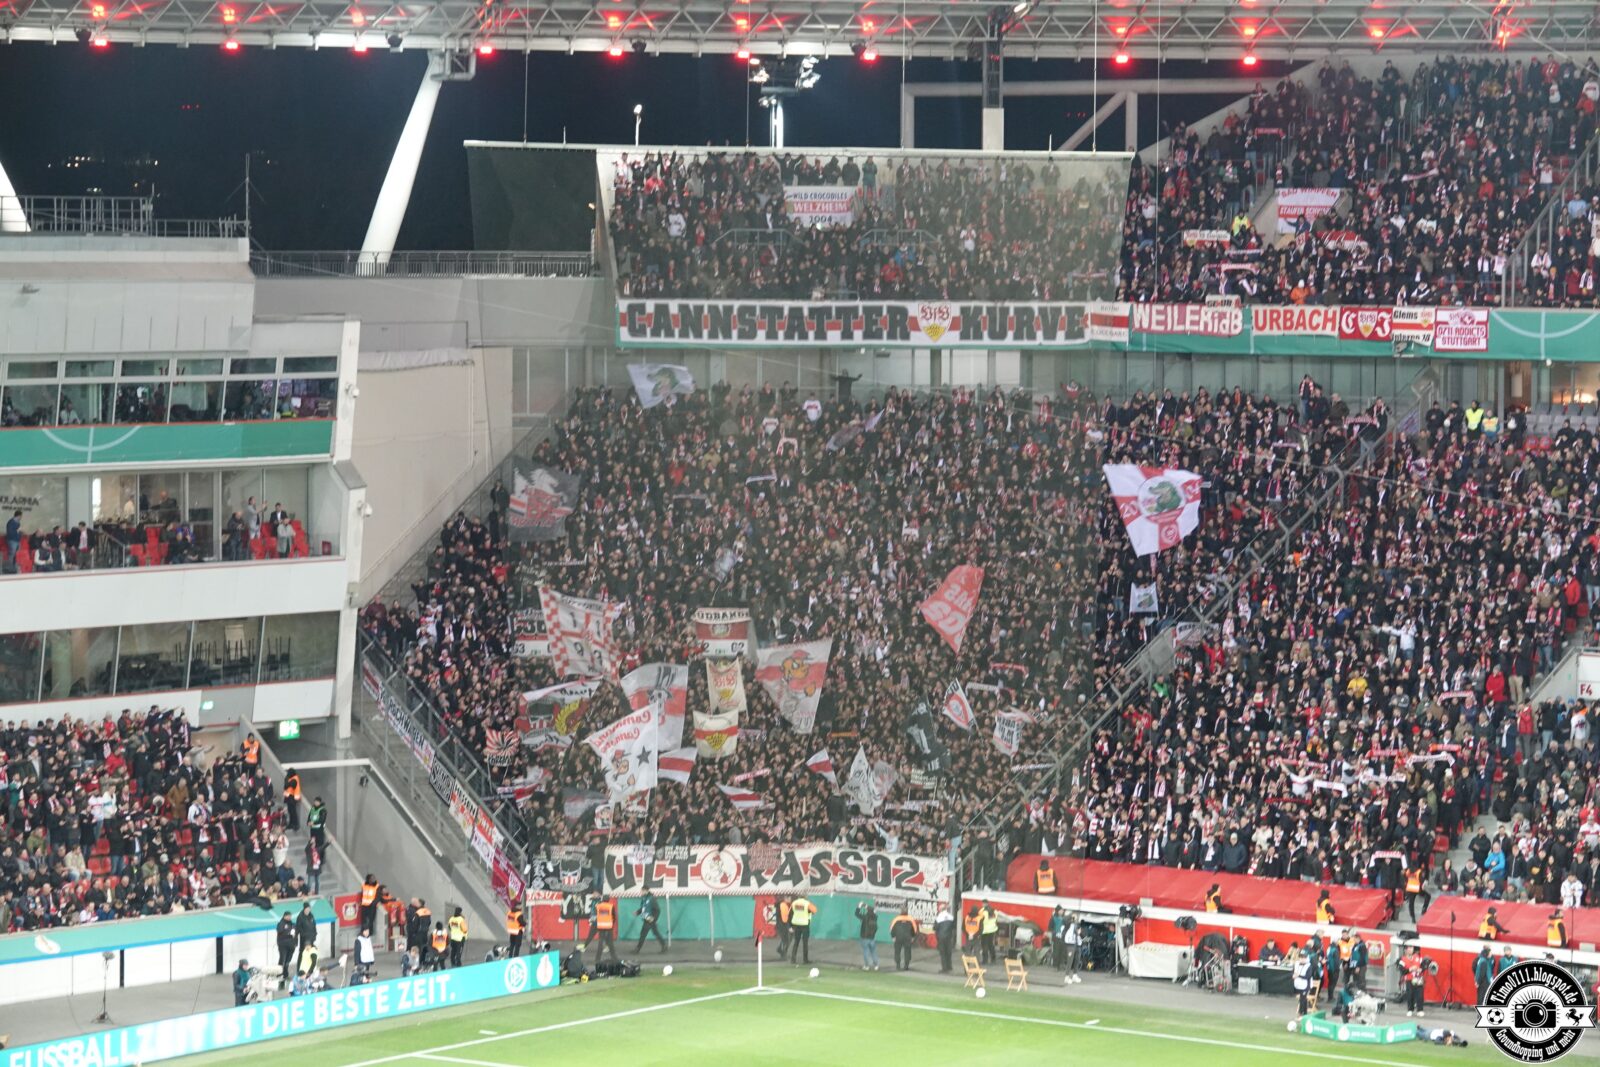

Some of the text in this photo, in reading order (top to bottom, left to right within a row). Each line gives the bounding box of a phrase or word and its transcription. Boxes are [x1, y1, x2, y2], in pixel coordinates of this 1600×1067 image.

[793, 201, 848, 212] WELZHEIM
[1253, 306, 1337, 333] URBACH
[1393, 310, 1418, 321] Glems
[626, 303, 911, 341] CANNSTATTER
[959, 305, 1086, 341] KURVE
[1454, 326, 1486, 337] ADDICTS
[1441, 337, 1481, 347] STUTTGART
[1580, 683, 1593, 696] F4
[213, 1009, 258, 1044] IST
[262, 1000, 305, 1035] DIE
[313, 986, 390, 1026] BESTE
[397, 973, 456, 1011] ZEIT.
